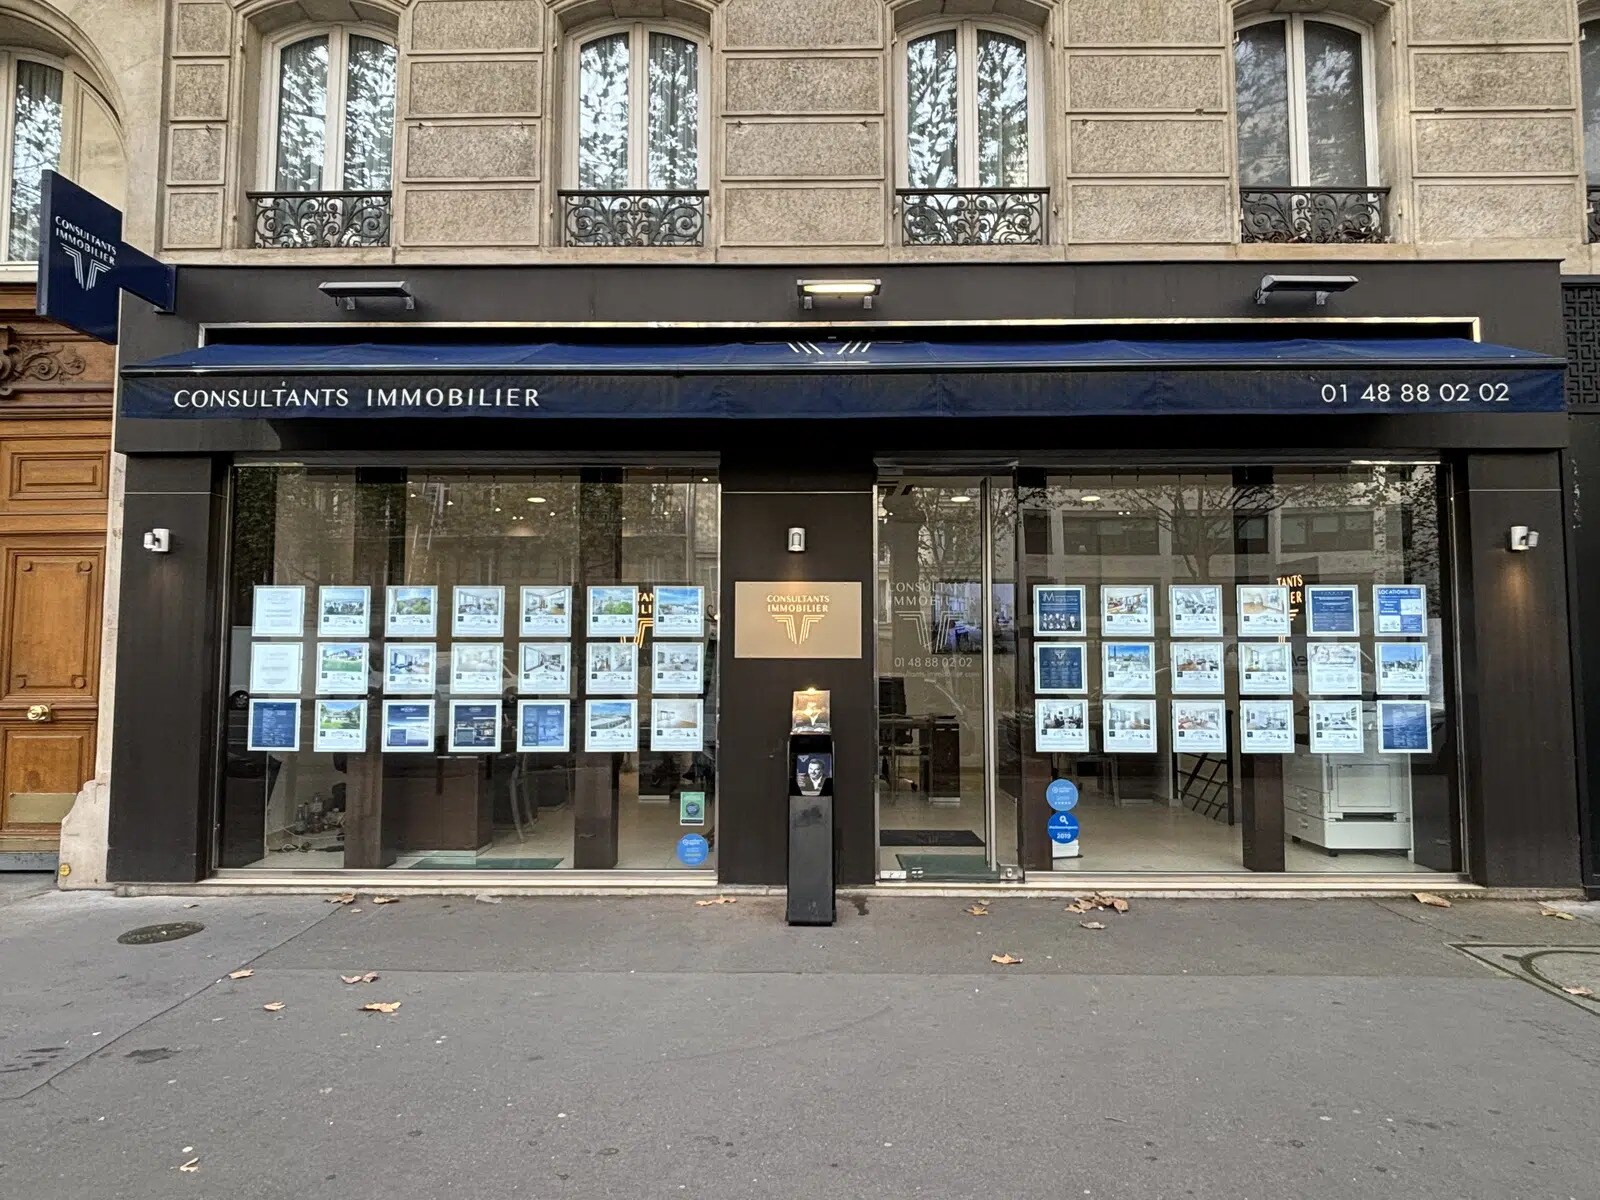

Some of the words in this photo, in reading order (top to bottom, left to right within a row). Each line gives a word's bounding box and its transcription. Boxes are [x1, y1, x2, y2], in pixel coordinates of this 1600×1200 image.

[55, 215, 117, 255] CONSULTANTS
[56, 227, 115, 266] IMMOBILIER
[174, 388, 349, 408] CONSULTANTS
[367, 387, 540, 407] IMMOBILIER
[1321, 384, 1348, 402] 01
[1360, 383, 1391, 402] 48
[1400, 383, 1431, 402] 88
[1439, 383, 1471, 402] 02
[1478, 383, 1510, 401] 02
[889, 582, 978, 593] CONSULTAN
[766, 594, 830, 603] CONSULTANTS
[888, 595, 977, 606] MMOBILIR
[767, 604, 829, 613] IMMOBILIER
[894, 657, 905, 668] 01
[907, 657, 922, 668] 48
[924, 657, 939, 668] 88
[941, 657, 957, 668] 02
[958, 657, 973, 668] 02
